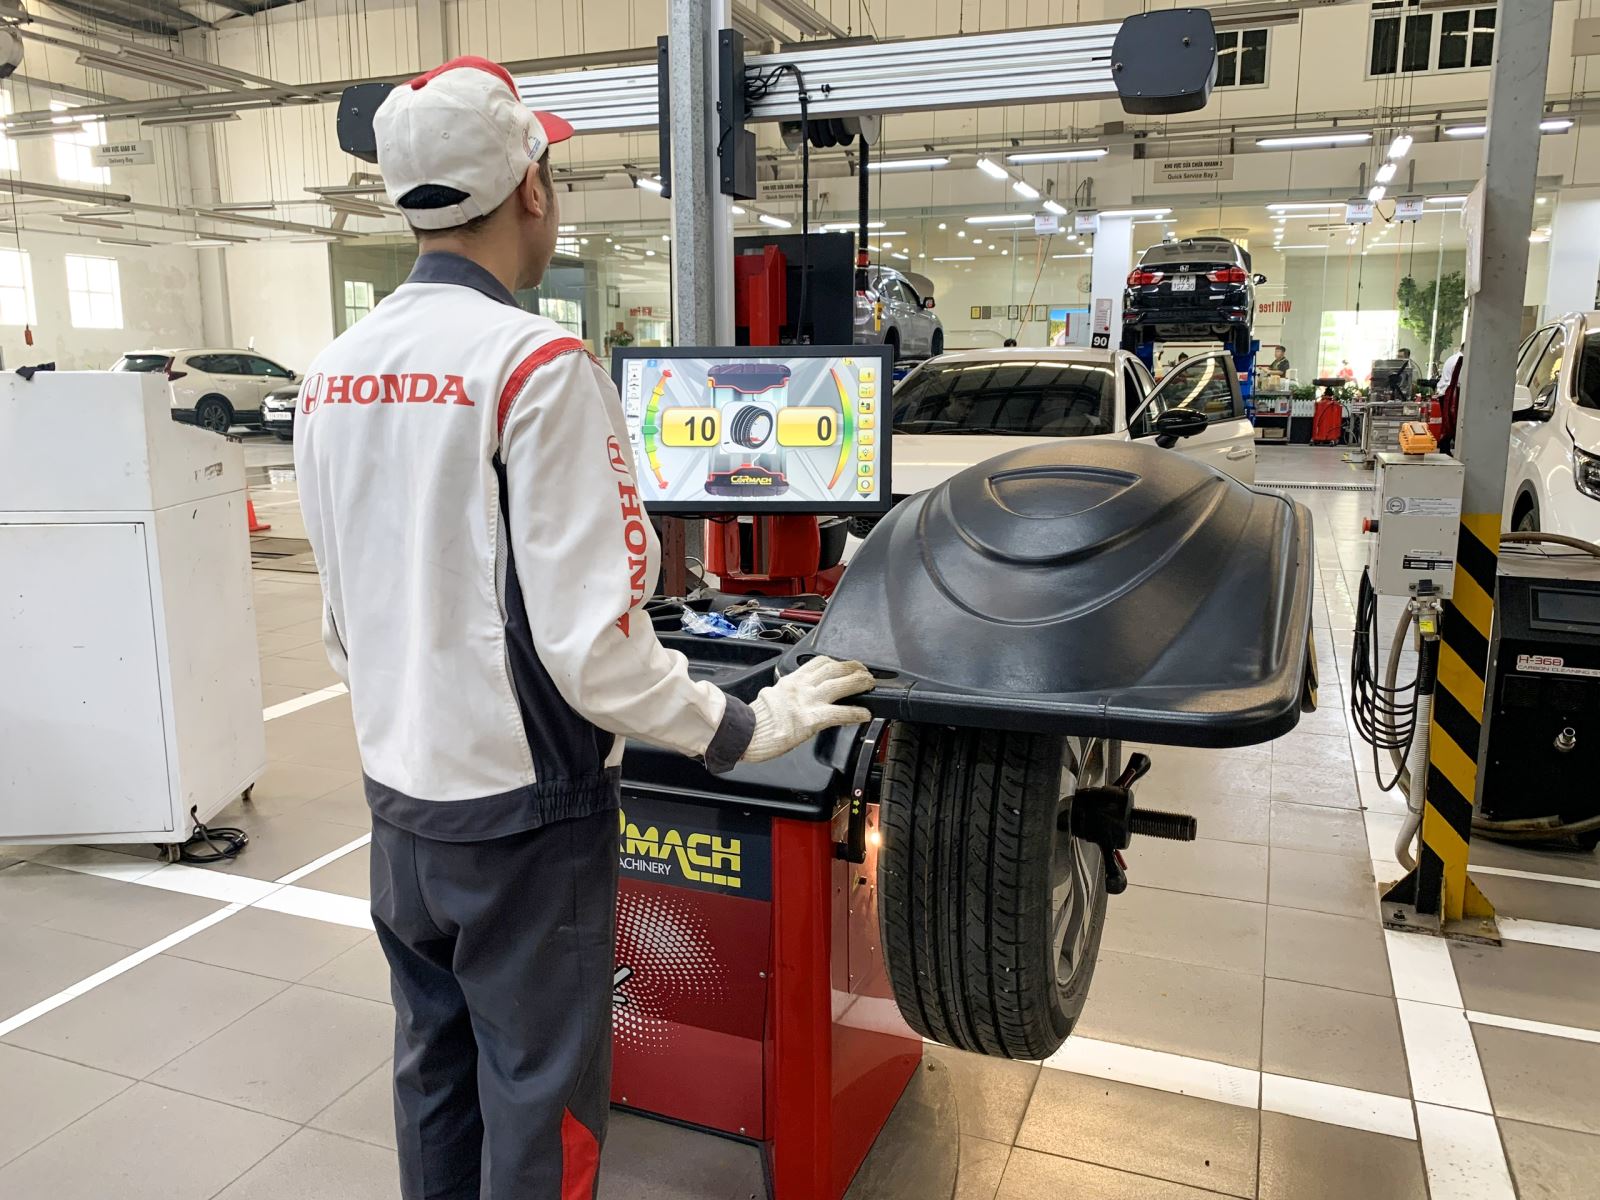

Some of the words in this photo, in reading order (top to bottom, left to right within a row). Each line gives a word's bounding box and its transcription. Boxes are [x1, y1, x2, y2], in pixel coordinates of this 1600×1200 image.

[1203, 171, 1214, 179] Bay
[1093, 336, 1108, 347] 90
[323, 373, 475, 407] HONDA
[684, 416, 716, 442] 10
[816, 415, 832, 441] 0
[1518, 655, 1562, 667] H-368
[1517, 664, 1550, 672] CARBON
[1551, 667, 1591, 676] CLEANING
